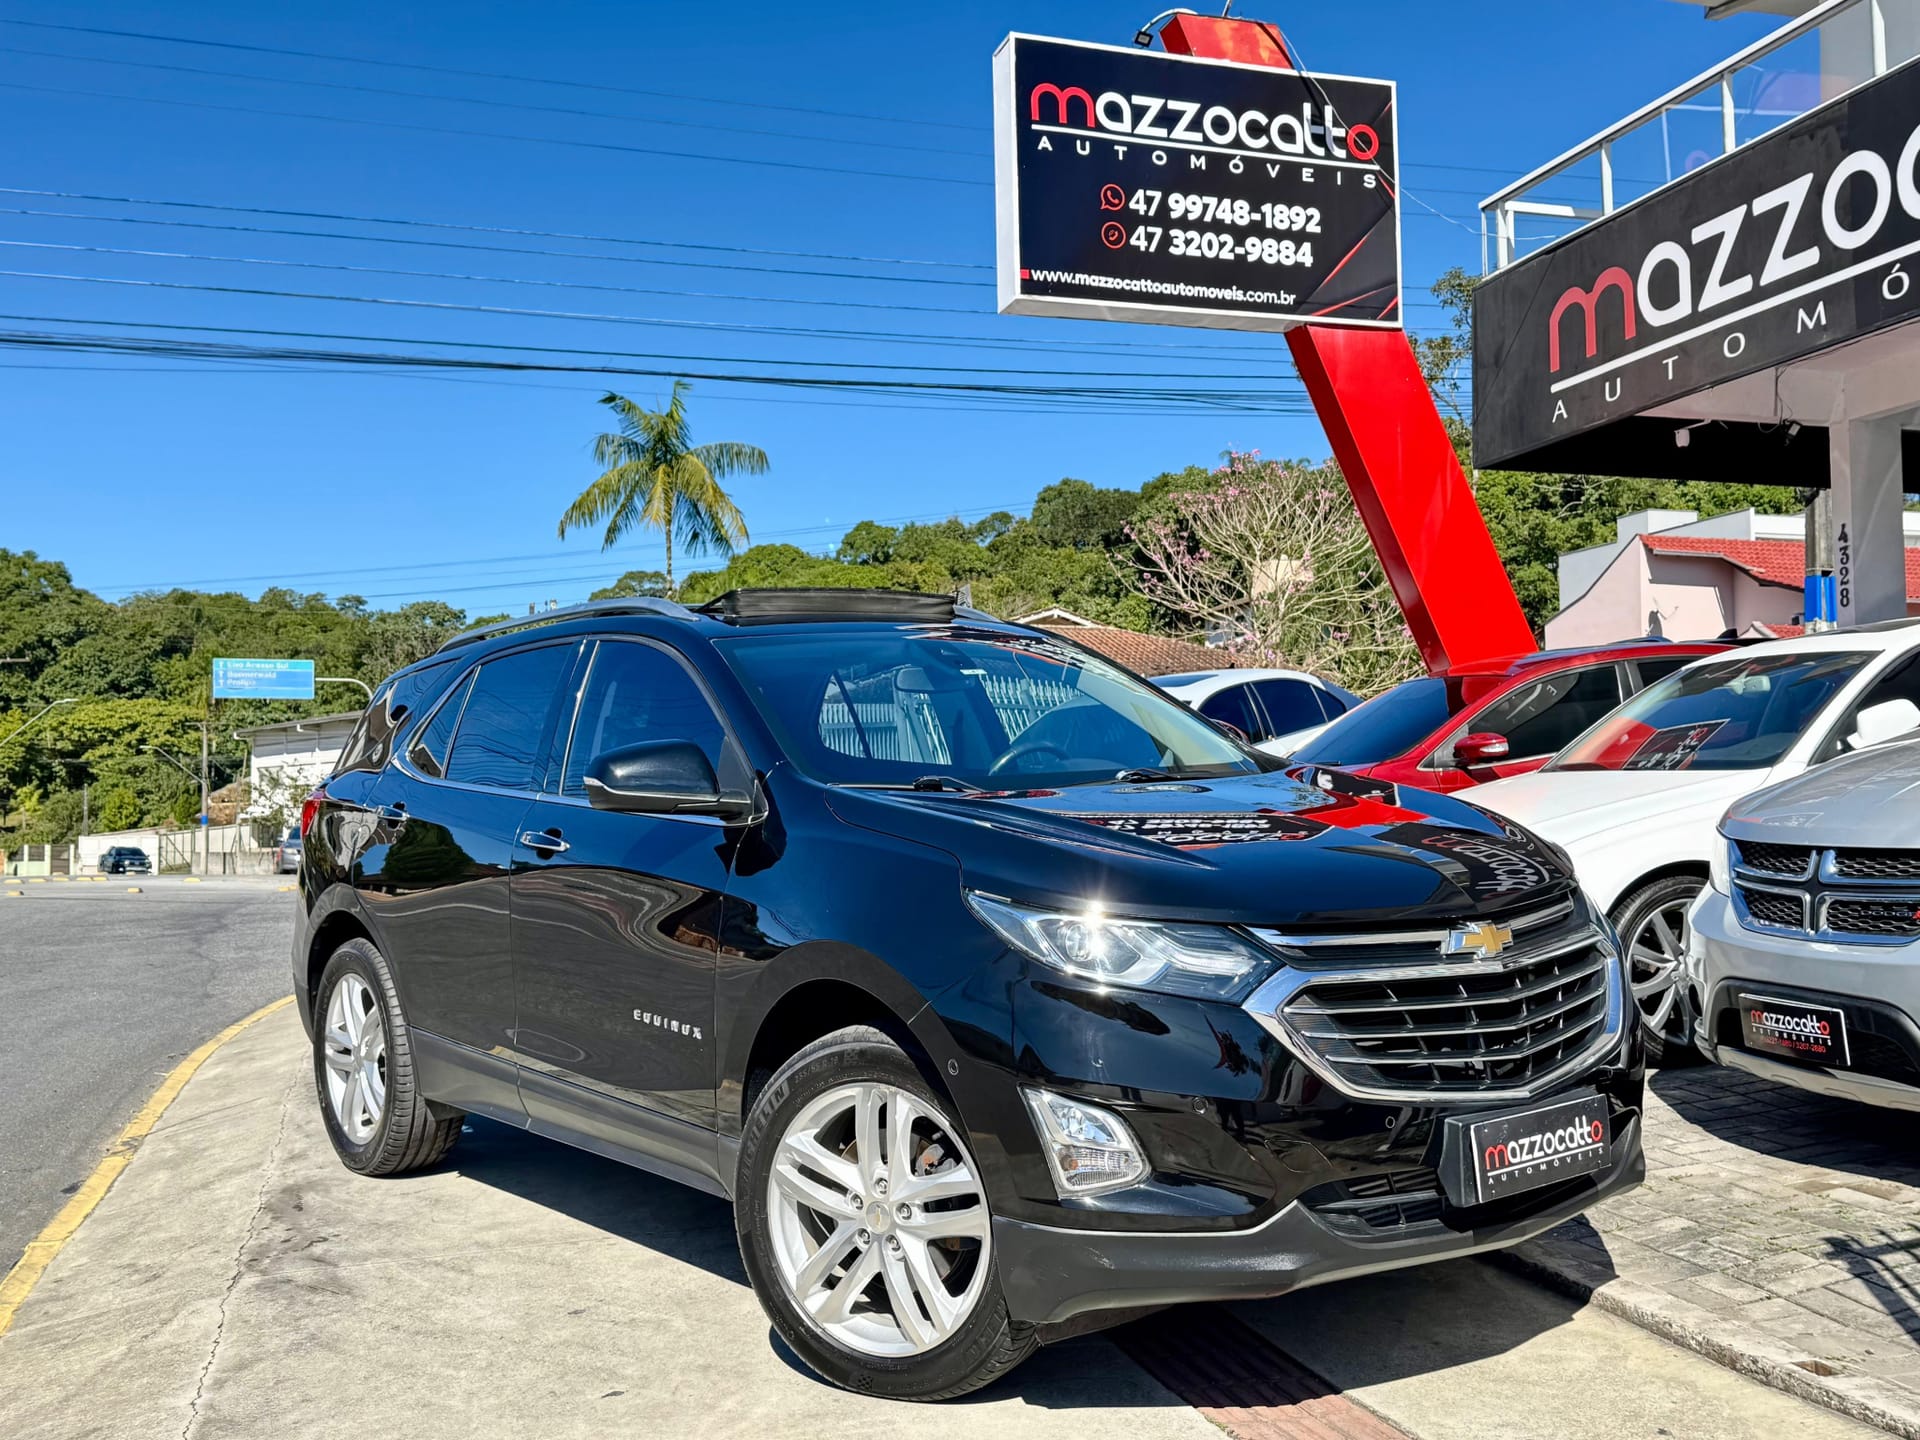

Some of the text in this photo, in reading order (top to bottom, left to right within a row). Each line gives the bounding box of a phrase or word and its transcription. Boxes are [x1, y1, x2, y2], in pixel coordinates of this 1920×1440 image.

[1031, 82, 1380, 161] mazzocatto
[1037, 135, 1378, 189] AUTOMÓVEIS
[1128, 189, 1322, 234] 47 99748-1892
[1129, 225, 1314, 268] 47 3202-9884
[1030, 267, 1297, 306] www.mazzocattoautomoveis.com.br
[1838, 523, 1850, 608] 4328
[632, 1008, 703, 1040] EQUINOX
[1750, 1009, 1830, 1035] mazzocatto
[1484, 1114, 1604, 1170] mazzocatto
[1487, 1147, 1604, 1185] AUTOMÓVEIS
